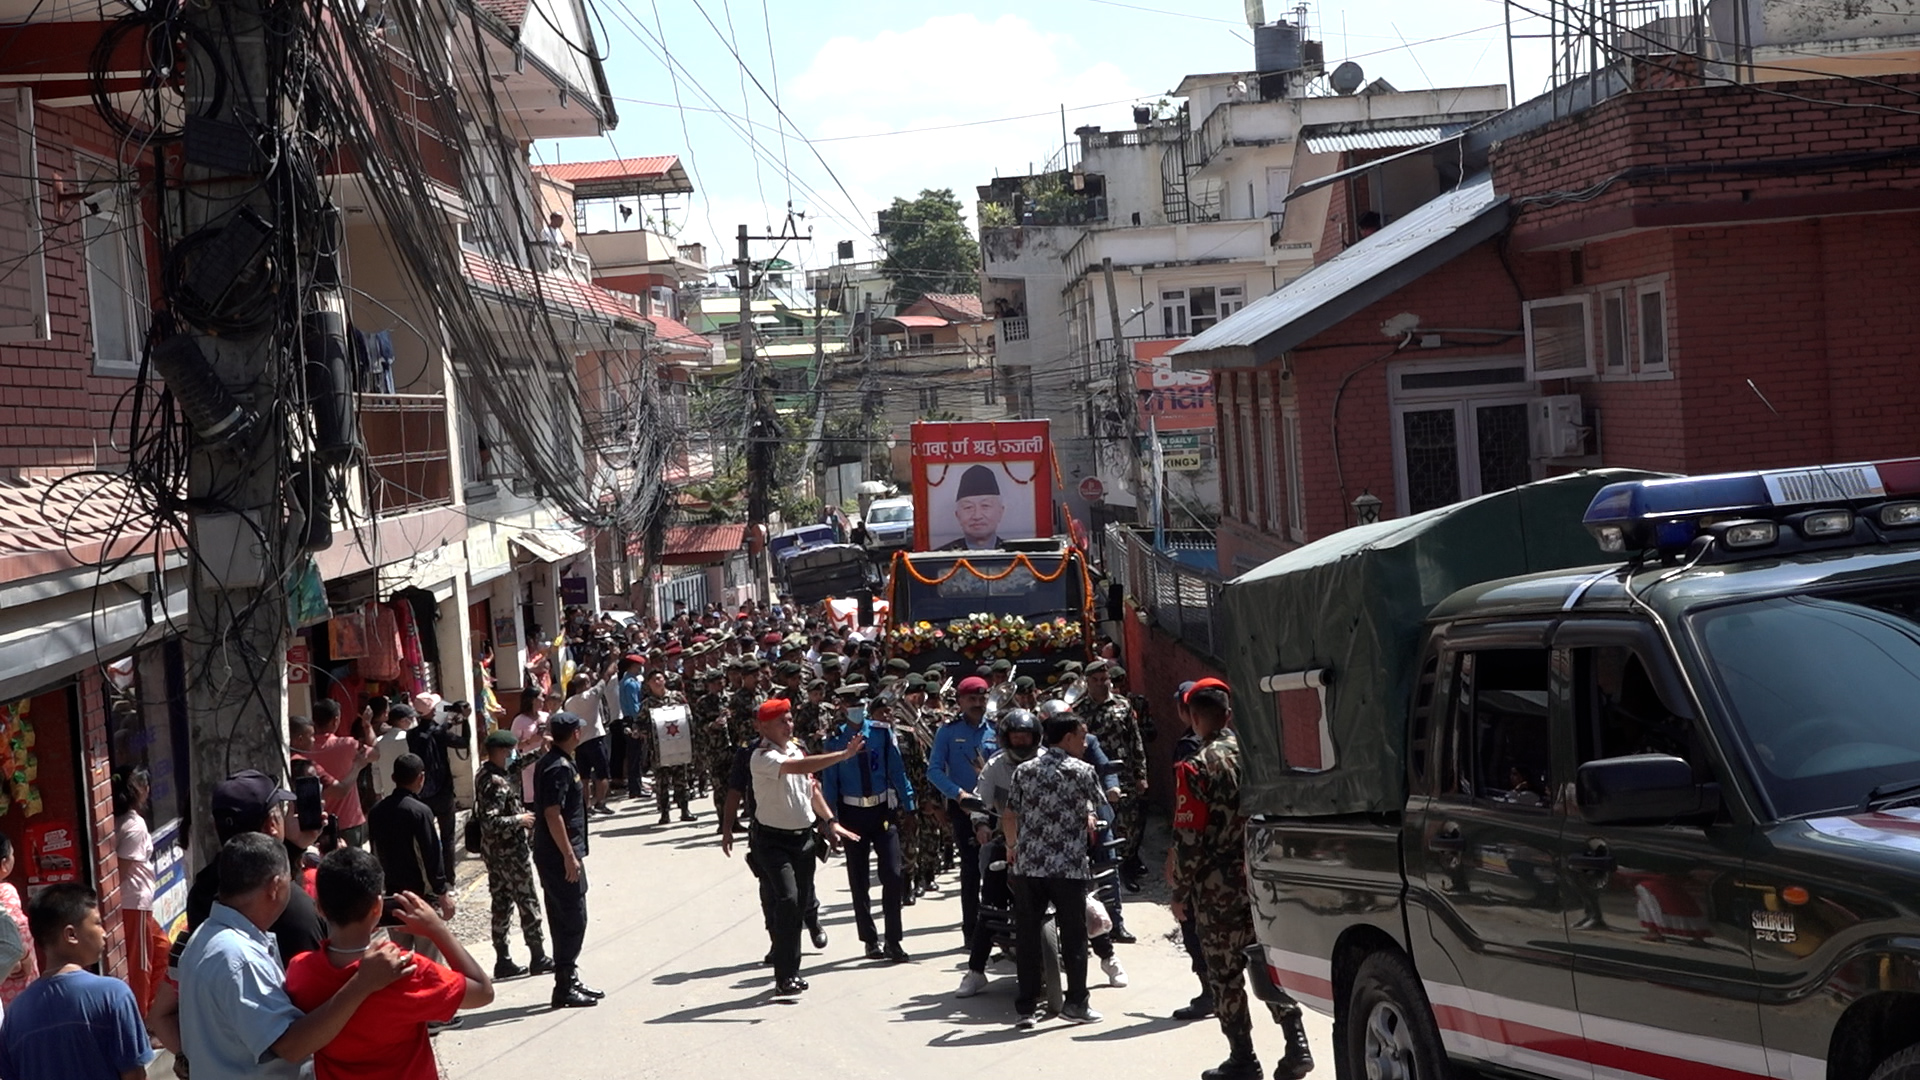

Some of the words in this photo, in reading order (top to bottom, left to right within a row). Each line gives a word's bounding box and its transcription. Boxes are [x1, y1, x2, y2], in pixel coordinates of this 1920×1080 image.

[1169, 437, 1192, 445] DAILY
[1143, 458, 1189, 468] PKING
[1751, 910, 1795, 932] SCORPIO
[1778, 932, 1797, 943] UP
